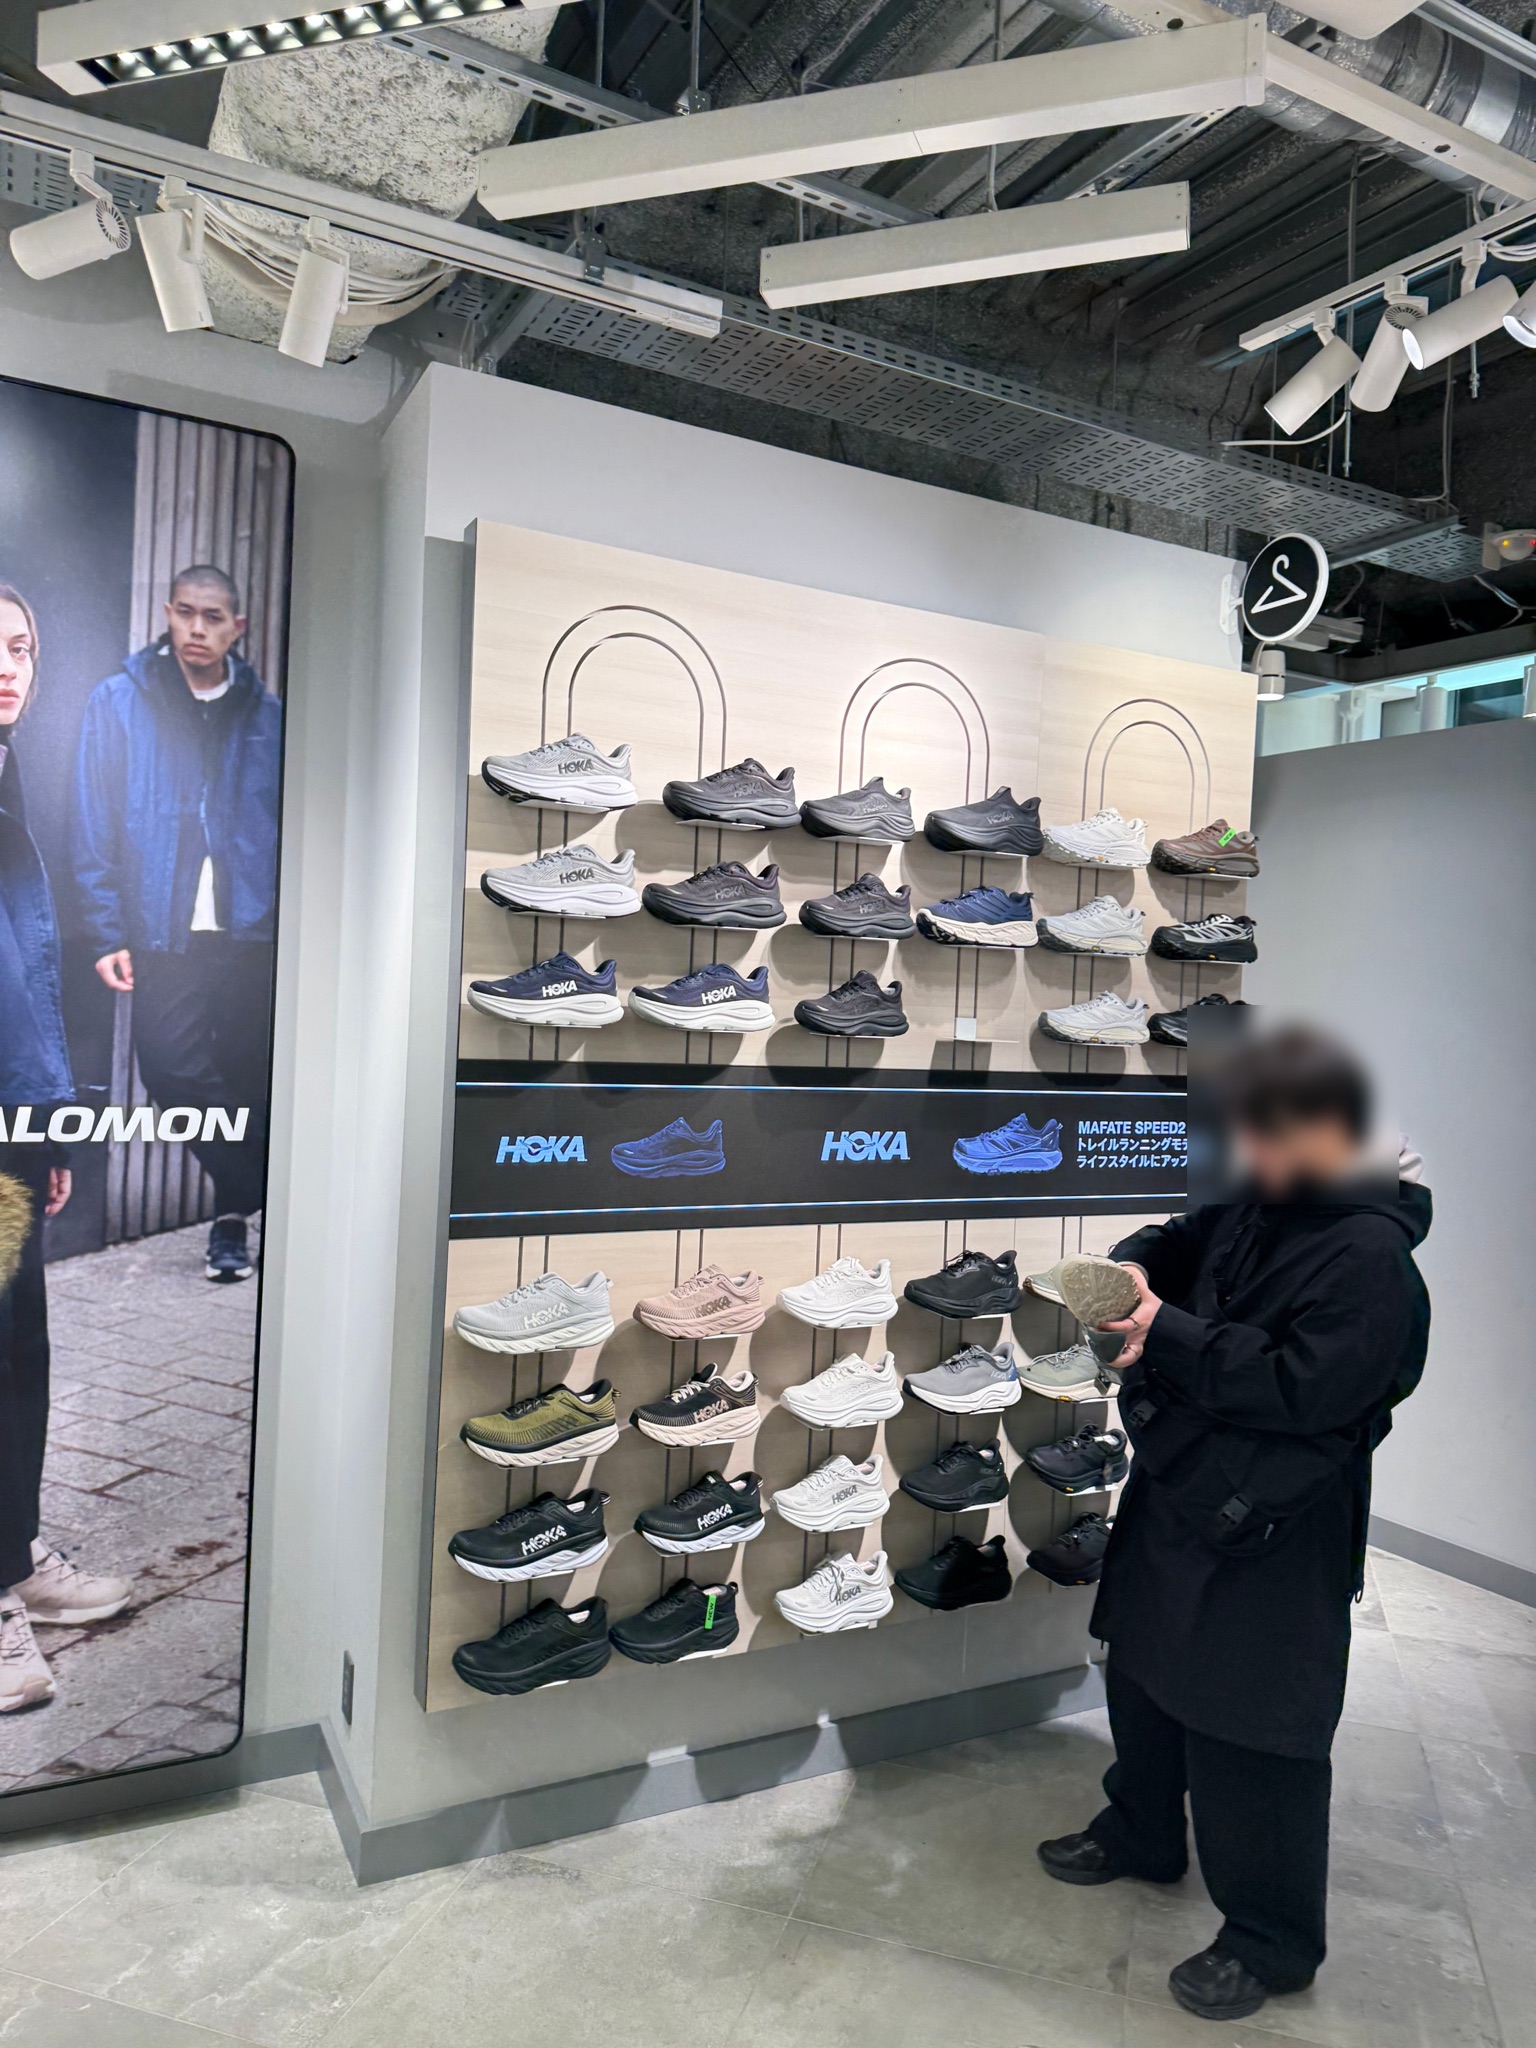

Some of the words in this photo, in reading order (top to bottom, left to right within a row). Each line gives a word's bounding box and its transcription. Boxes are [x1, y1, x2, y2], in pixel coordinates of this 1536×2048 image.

[557, 758, 595, 775] HOKA
[559, 867, 595, 885] HOKA
[714, 884, 747, 900] HOKA
[541, 979, 578, 998] HOKA
[701, 984, 737, 1005] HOKA
[1078, 1120, 1132, 1134] MAFATE
[1134, 1121, 1186, 1134] SPEED2
[495, 1135, 587, 1164] HOKA
[820, 1130, 911, 1161] HOKA
[693, 1399, 730, 1424] HOKA
[832, 1484, 858, 1505] HOKA
[697, 1503, 733, 1531] HOKA
[521, 1525, 567, 1556] HOKA
